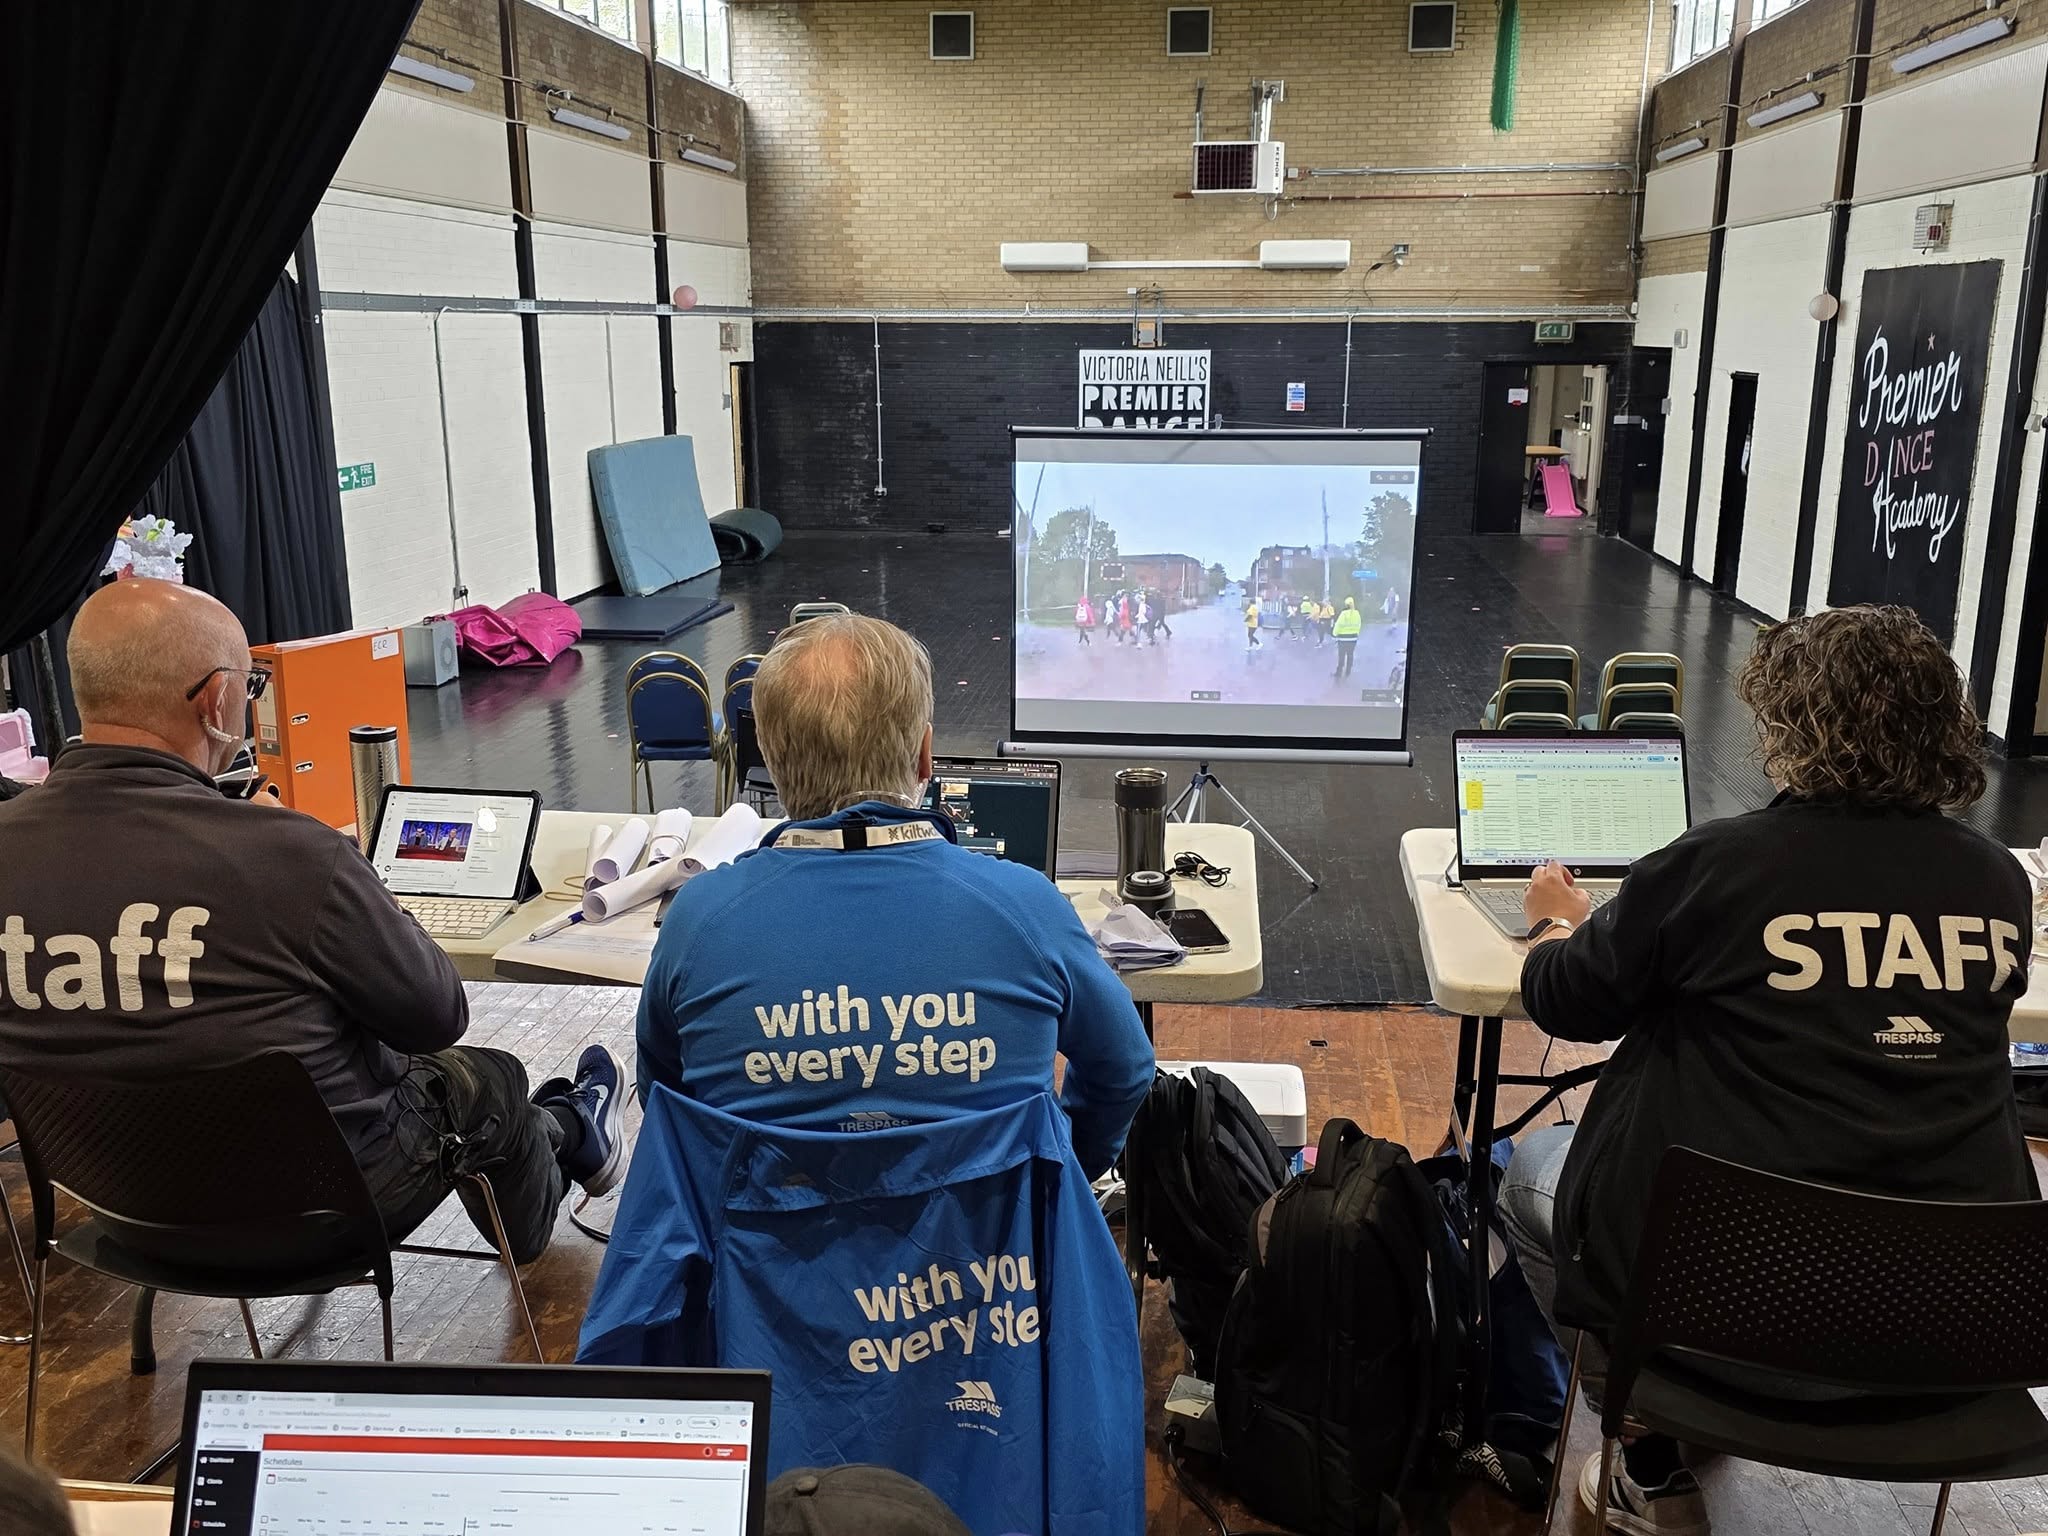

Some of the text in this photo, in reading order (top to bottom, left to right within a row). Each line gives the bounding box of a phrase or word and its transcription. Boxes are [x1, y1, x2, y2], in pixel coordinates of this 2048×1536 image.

[1083, 356, 1207, 381] VICTORIA NEILL'S
[1084, 385, 1203, 411] PREMIER
[1859, 325, 1962, 435] Premier
[1872, 437, 1960, 562] Academy
[0, 902, 210, 1011] taff
[1763, 912, 2019, 992] STAFF
[754, 985, 976, 1041] with you
[744, 1035, 996, 1088] every step
[853, 1263, 963, 1322] with
[848, 1300, 1040, 1373] every ste
[263, 1457, 303, 1466] Schedules
